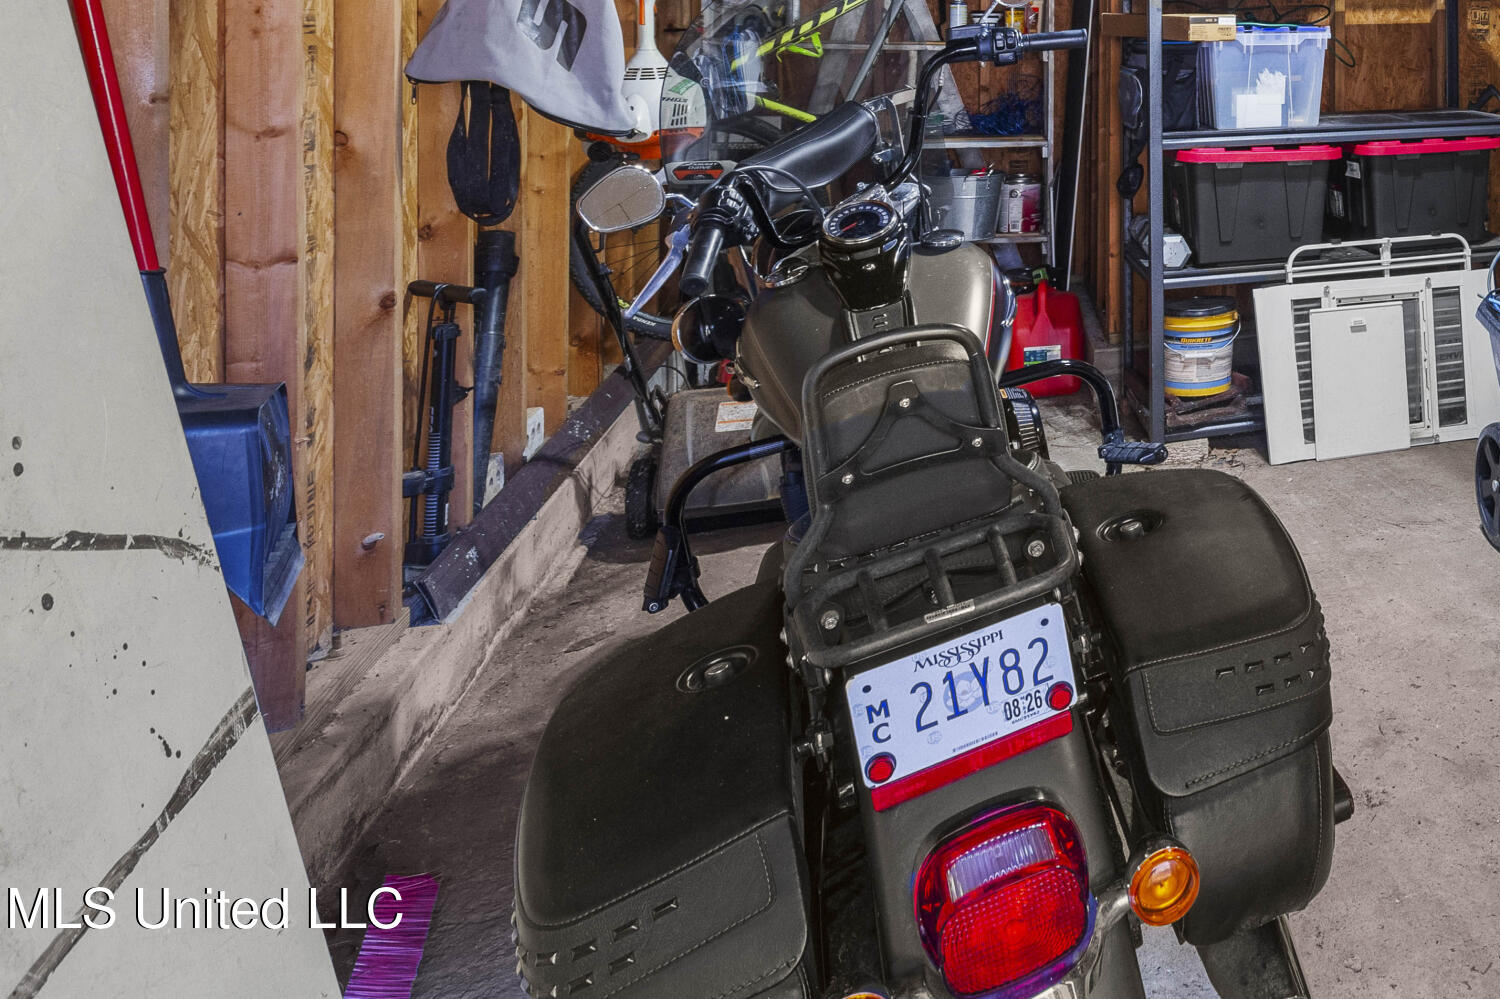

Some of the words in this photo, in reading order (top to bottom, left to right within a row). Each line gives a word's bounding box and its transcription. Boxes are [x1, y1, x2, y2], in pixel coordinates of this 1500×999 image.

[913, 629, 1004, 673] MISSISSIPPI
[910, 636, 1054, 733] 21Y82
[1003, 697, 1021, 721] 08
[1024, 689, 1043, 714] 26
